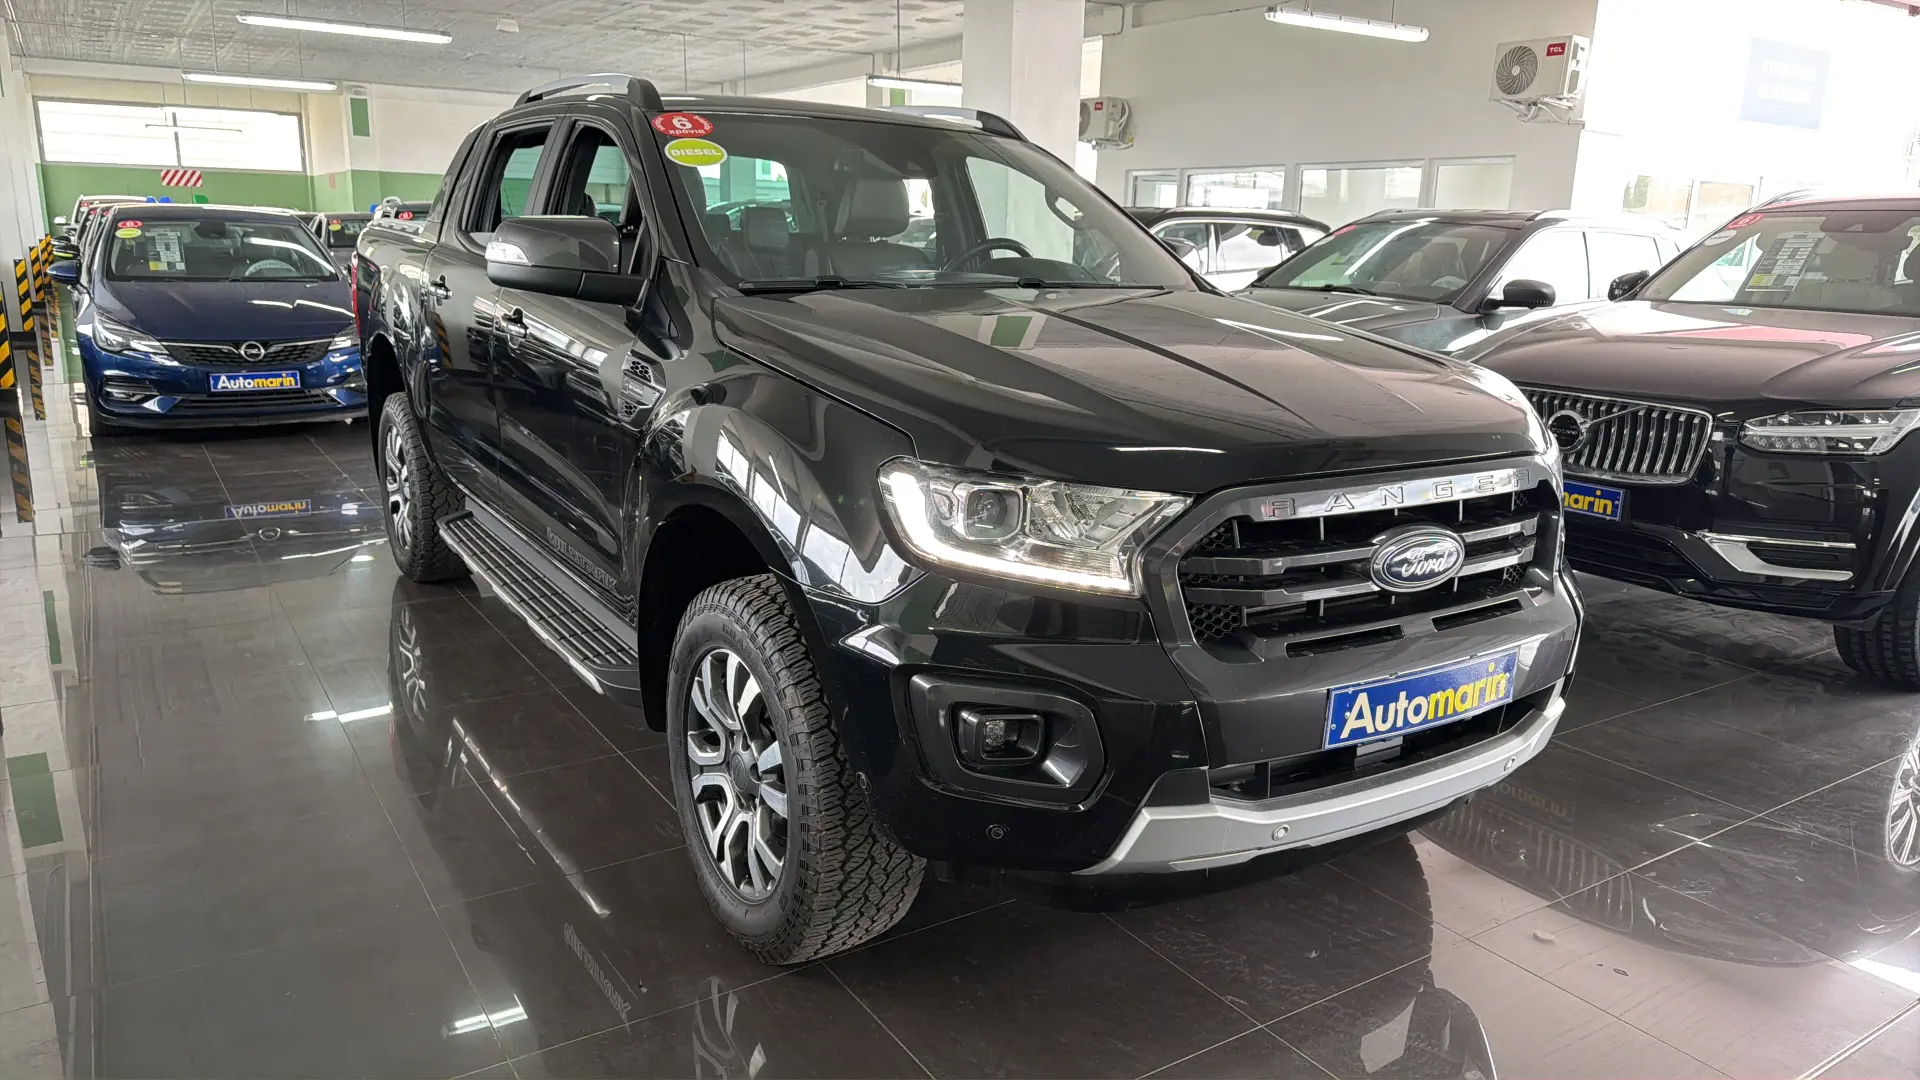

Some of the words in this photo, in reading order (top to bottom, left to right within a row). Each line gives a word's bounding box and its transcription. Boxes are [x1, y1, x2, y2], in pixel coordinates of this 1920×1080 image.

[672, 117, 692, 129] 6
[670, 148, 722, 156] DIESEL
[217, 372, 296, 389] Automarin
[1266, 468, 1531, 518] RANGER
[1401, 549, 1450, 578] Ford
[1340, 663, 1507, 739] Automarin
